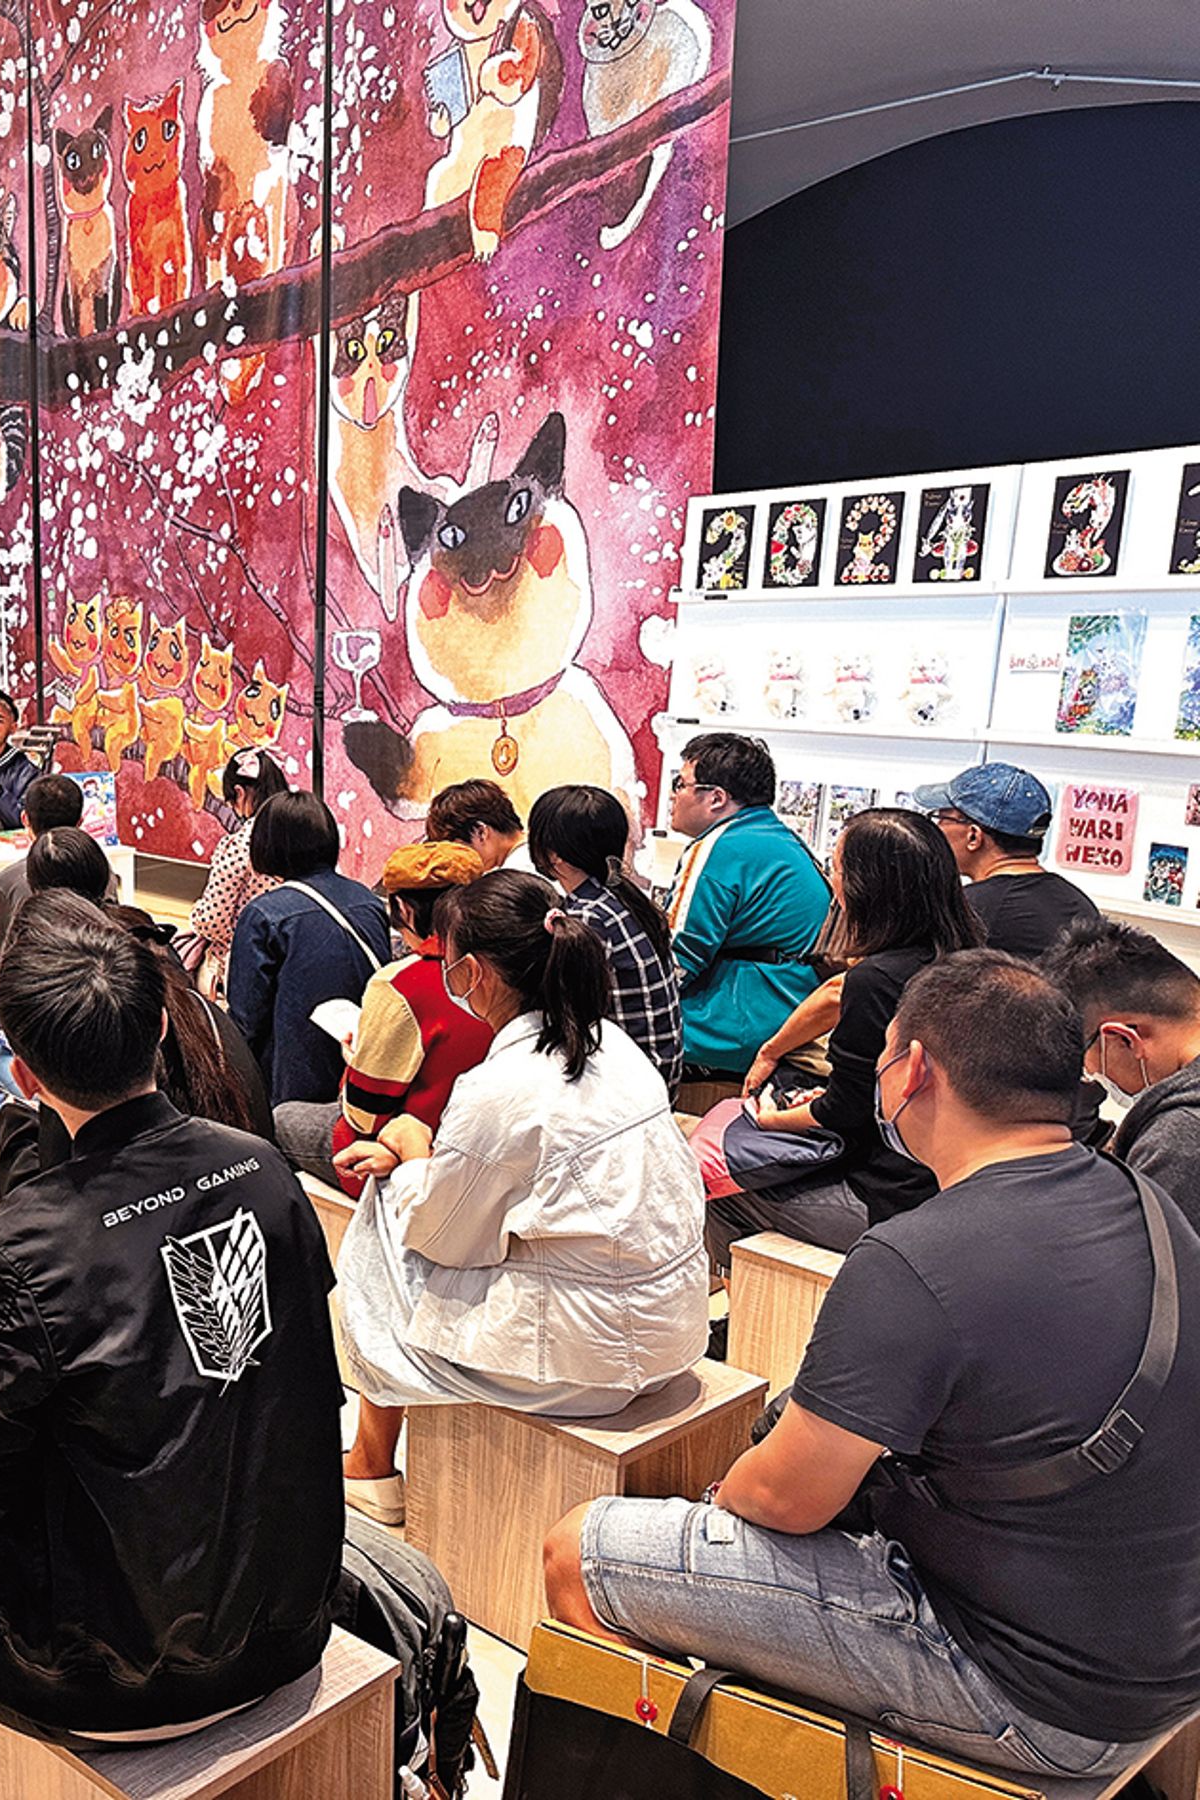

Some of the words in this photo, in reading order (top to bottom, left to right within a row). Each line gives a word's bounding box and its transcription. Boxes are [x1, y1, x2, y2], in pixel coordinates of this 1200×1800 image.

[1069, 818, 1124, 841] WARI
[1065, 844, 1124, 869] NEKO
[102, 1186, 187, 1229] BEYOND
[196, 1157, 261, 1192] GAMING
